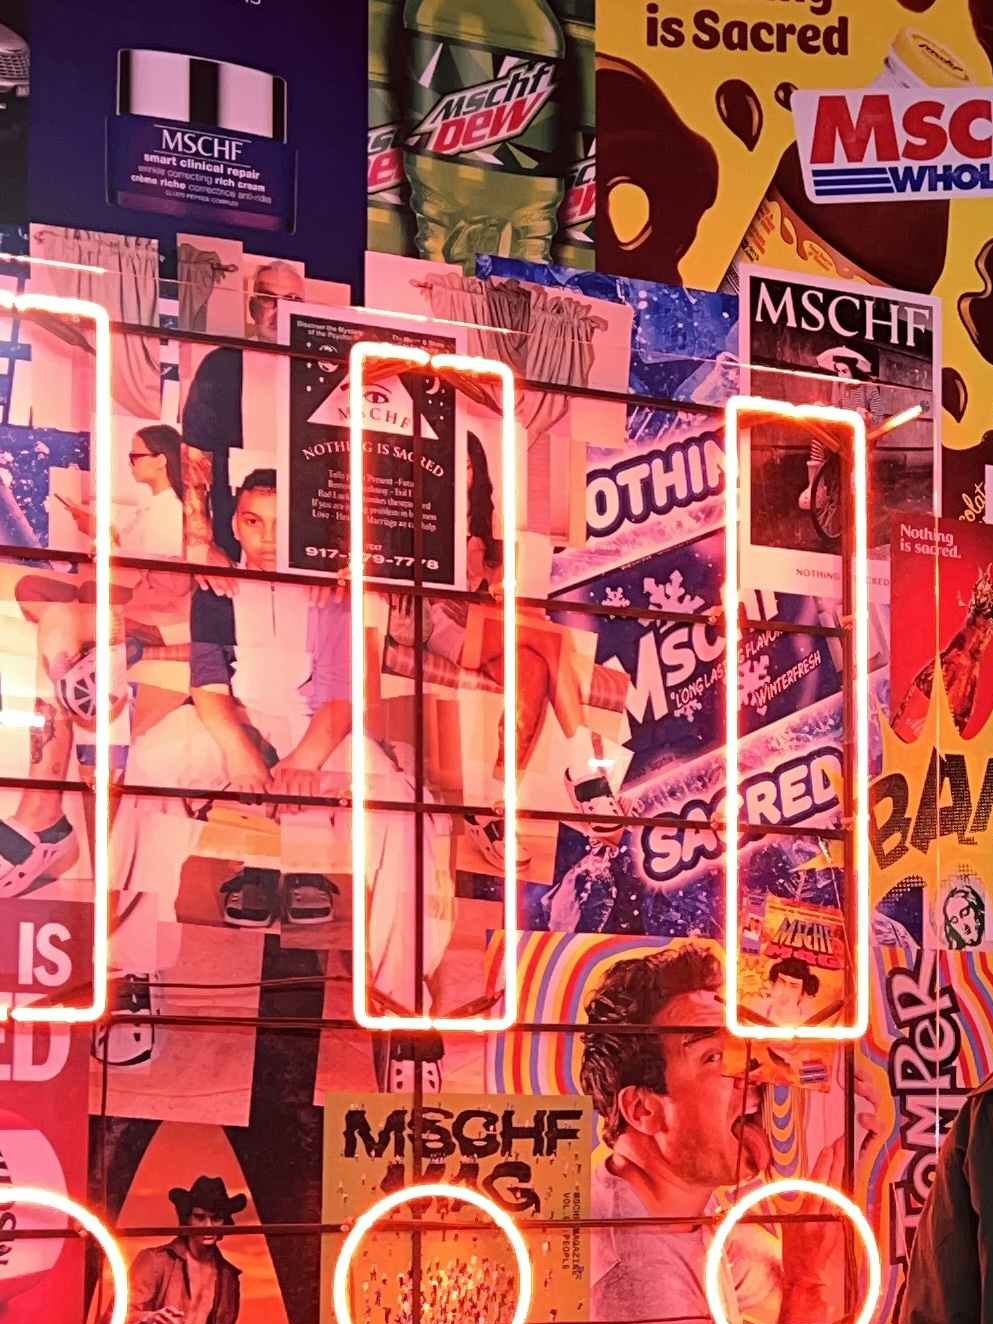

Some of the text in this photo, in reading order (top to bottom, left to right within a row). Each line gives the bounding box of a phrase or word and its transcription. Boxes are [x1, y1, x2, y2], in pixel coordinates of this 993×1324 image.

[646, 3, 849, 55] is Sacred
[162, 129, 243, 160] MSCHF
[144, 154, 260, 180] smart clinical repair
[755, 281, 929, 347] MSCHF
[302, 442, 373, 460] NOTHIG
[377, 443, 390, 455] IS
[588, 438, 727, 530] OTHIN
[900, 524, 954, 546] Nothing
[900, 538, 962, 560] is sacred.
[797, 569, 841, 581] NOTHING
[754, 649, 822, 706] WINTERFRESH
[18, 921, 72, 987] IS
[343, 1107, 583, 1159] MSCHF
